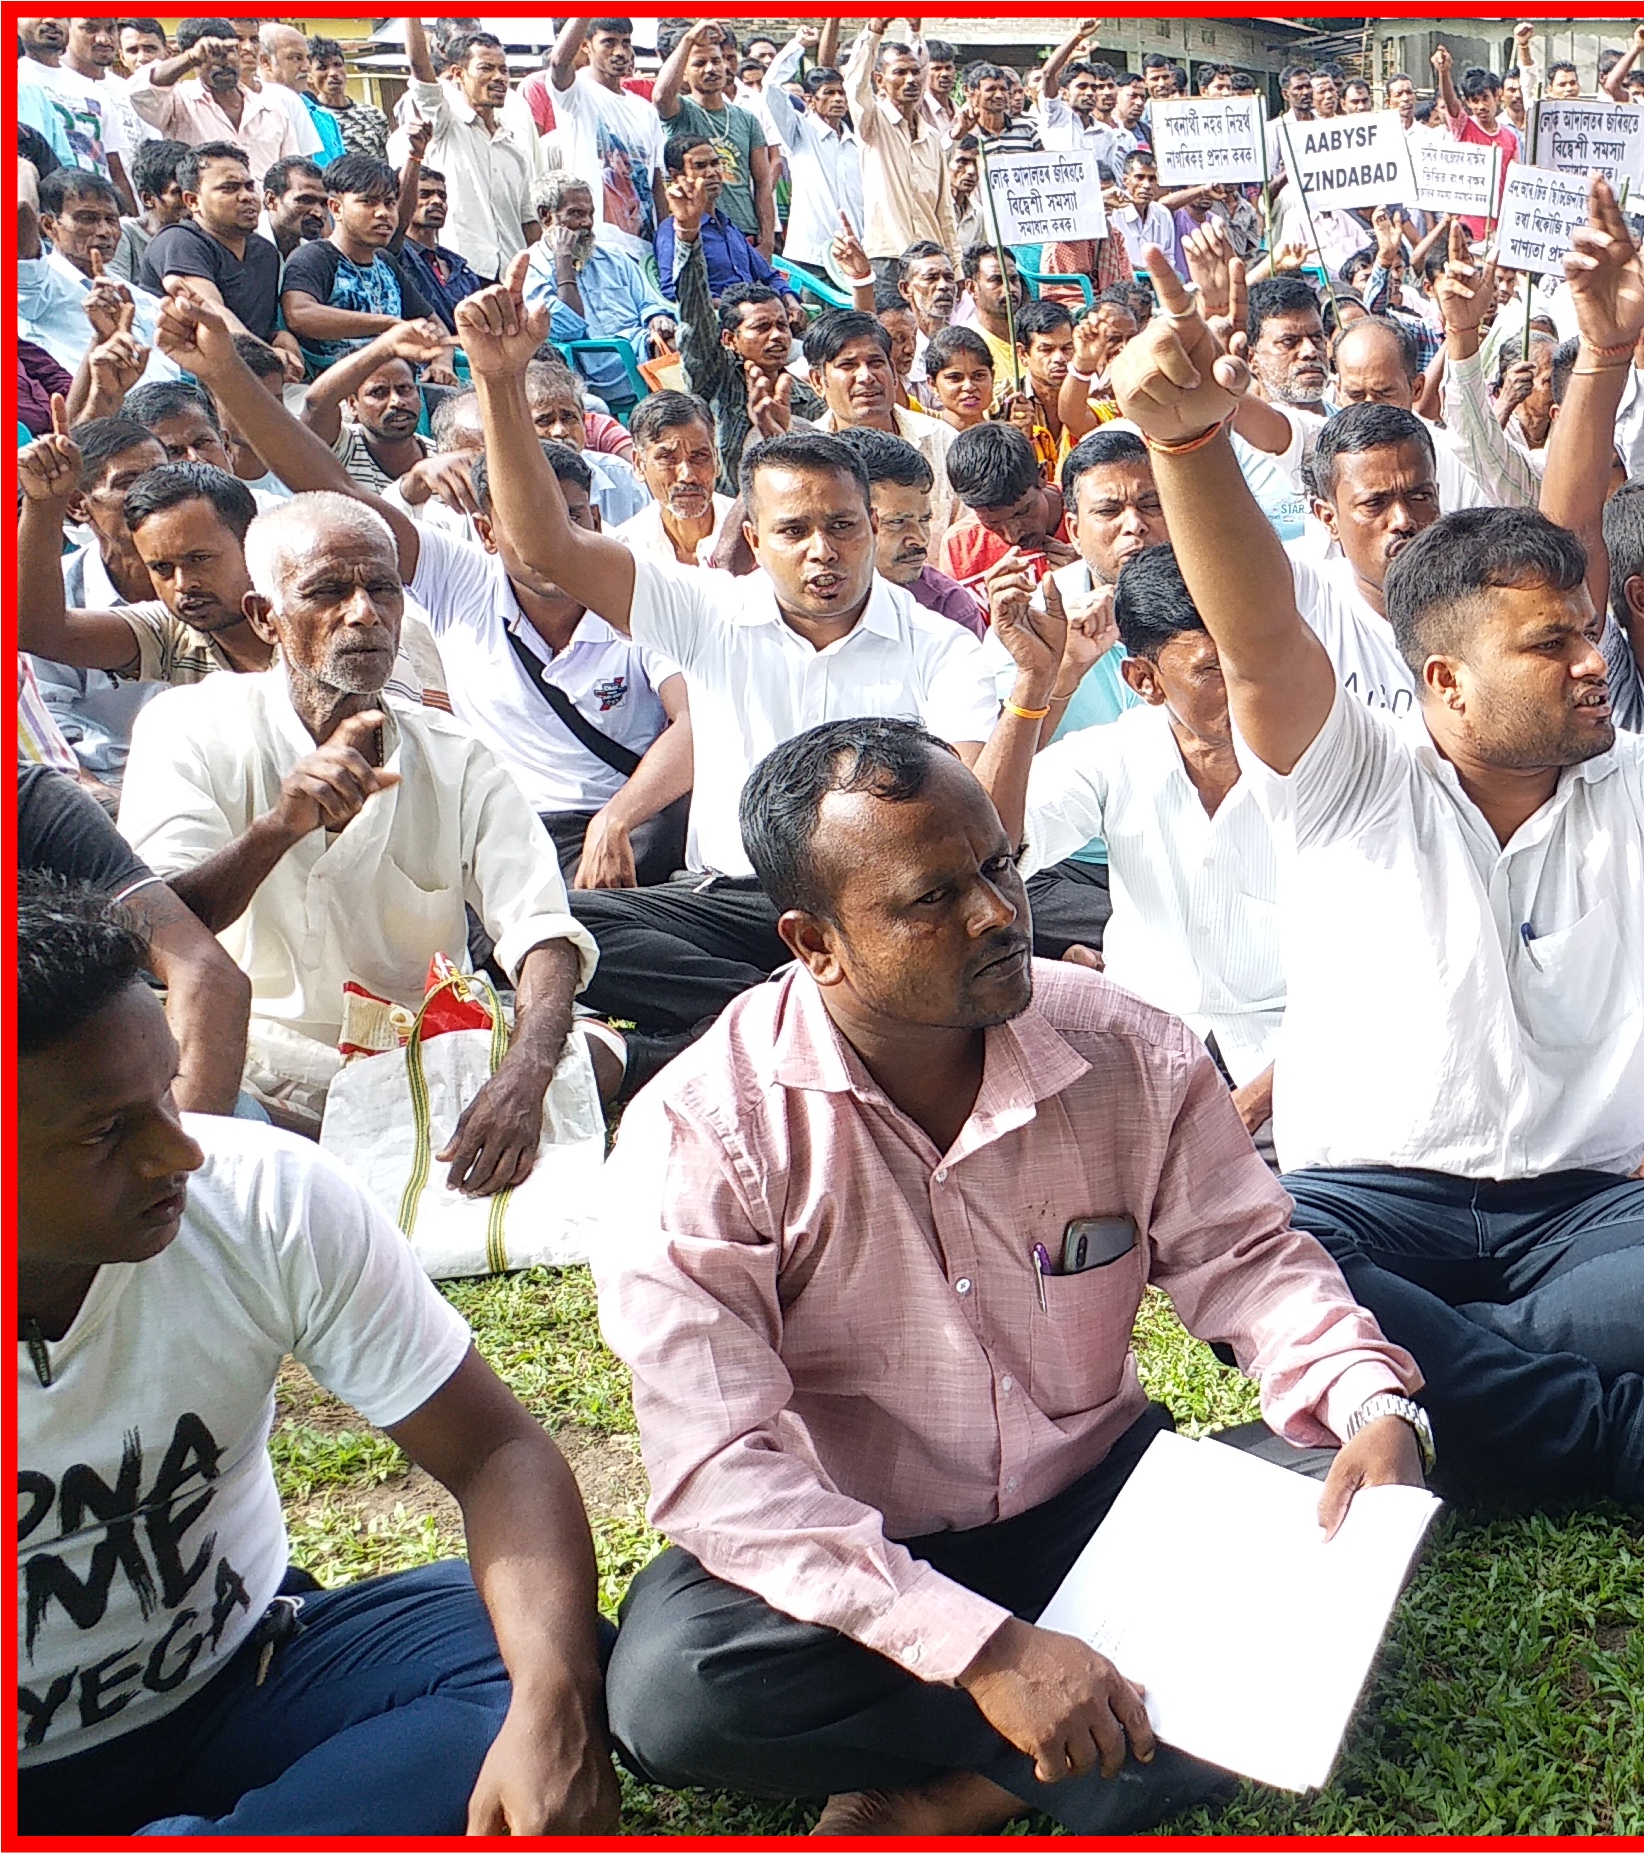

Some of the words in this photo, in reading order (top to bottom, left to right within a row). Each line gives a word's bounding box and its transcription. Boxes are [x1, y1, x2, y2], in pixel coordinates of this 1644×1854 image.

[1540, 110, 1561, 133] লোক
[1562, 108, 1604, 132] আদালতৰ
[1305, 124, 1378, 155] AABYSF
[1592, 140, 1626, 162] সমস্যা
[990, 168, 1009, 190] লোক
[1011, 164, 1051, 187] আদালতৰ
[1303, 161, 1398, 193] ZINDABAD
[1045, 190, 1077, 211] সমস্যা
[1018, 218, 1049, 236] সমাধান
[1281, 504, 1304, 514] STAR
